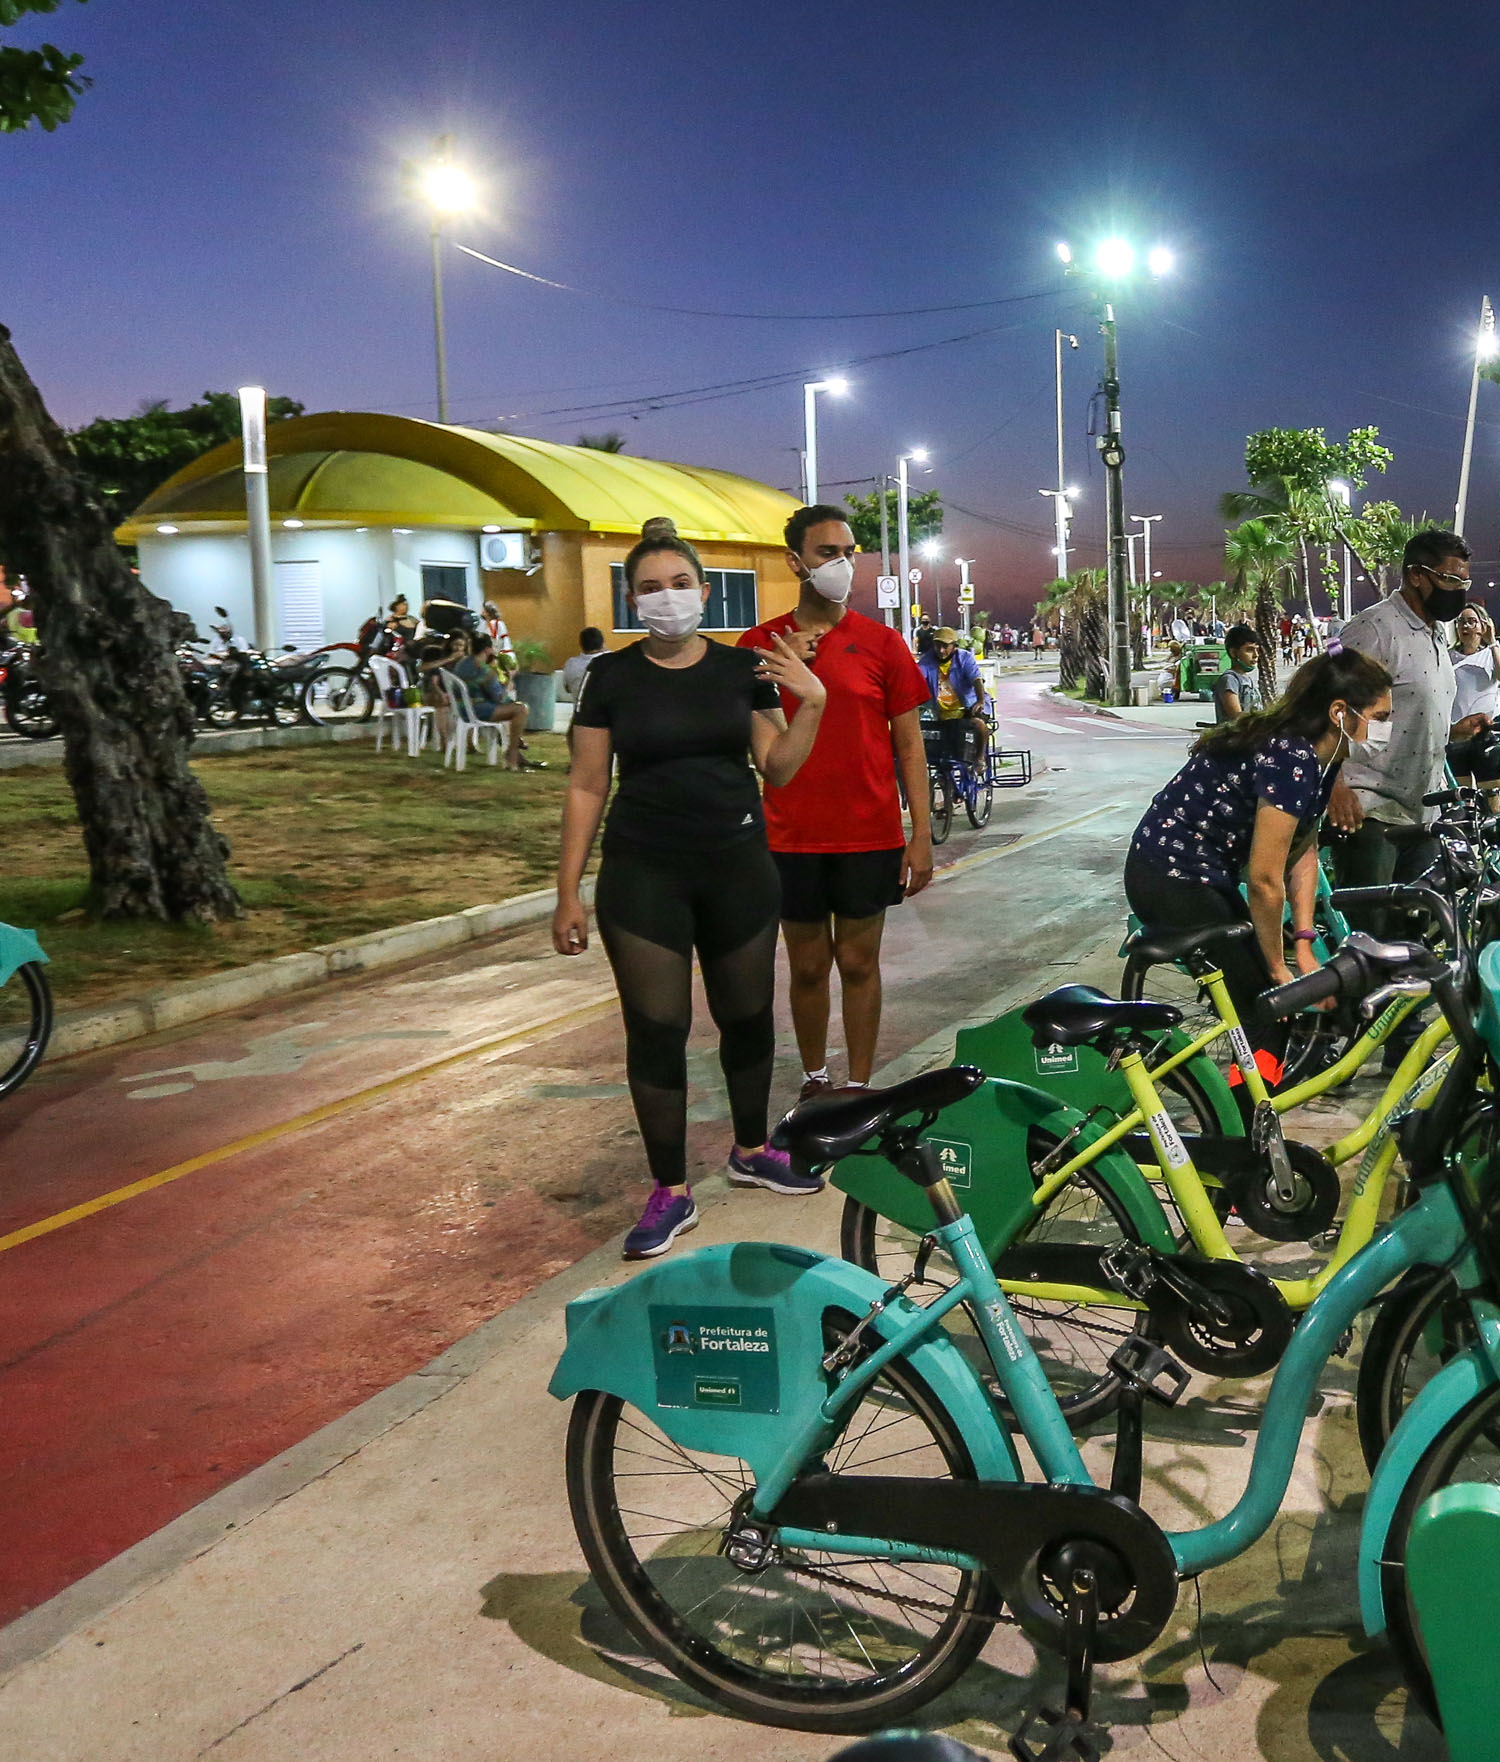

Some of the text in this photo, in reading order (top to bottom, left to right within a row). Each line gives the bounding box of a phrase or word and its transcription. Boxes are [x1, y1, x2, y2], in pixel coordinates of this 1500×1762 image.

[1041, 1054, 1073, 1064] Unimed
[942, 1162, 966, 1174] imed
[699, 1326, 768, 1338] Prefeitura de
[701, 1338, 769, 1352] Fortaleza
[996, 1321, 1017, 1361] Fortaleza
